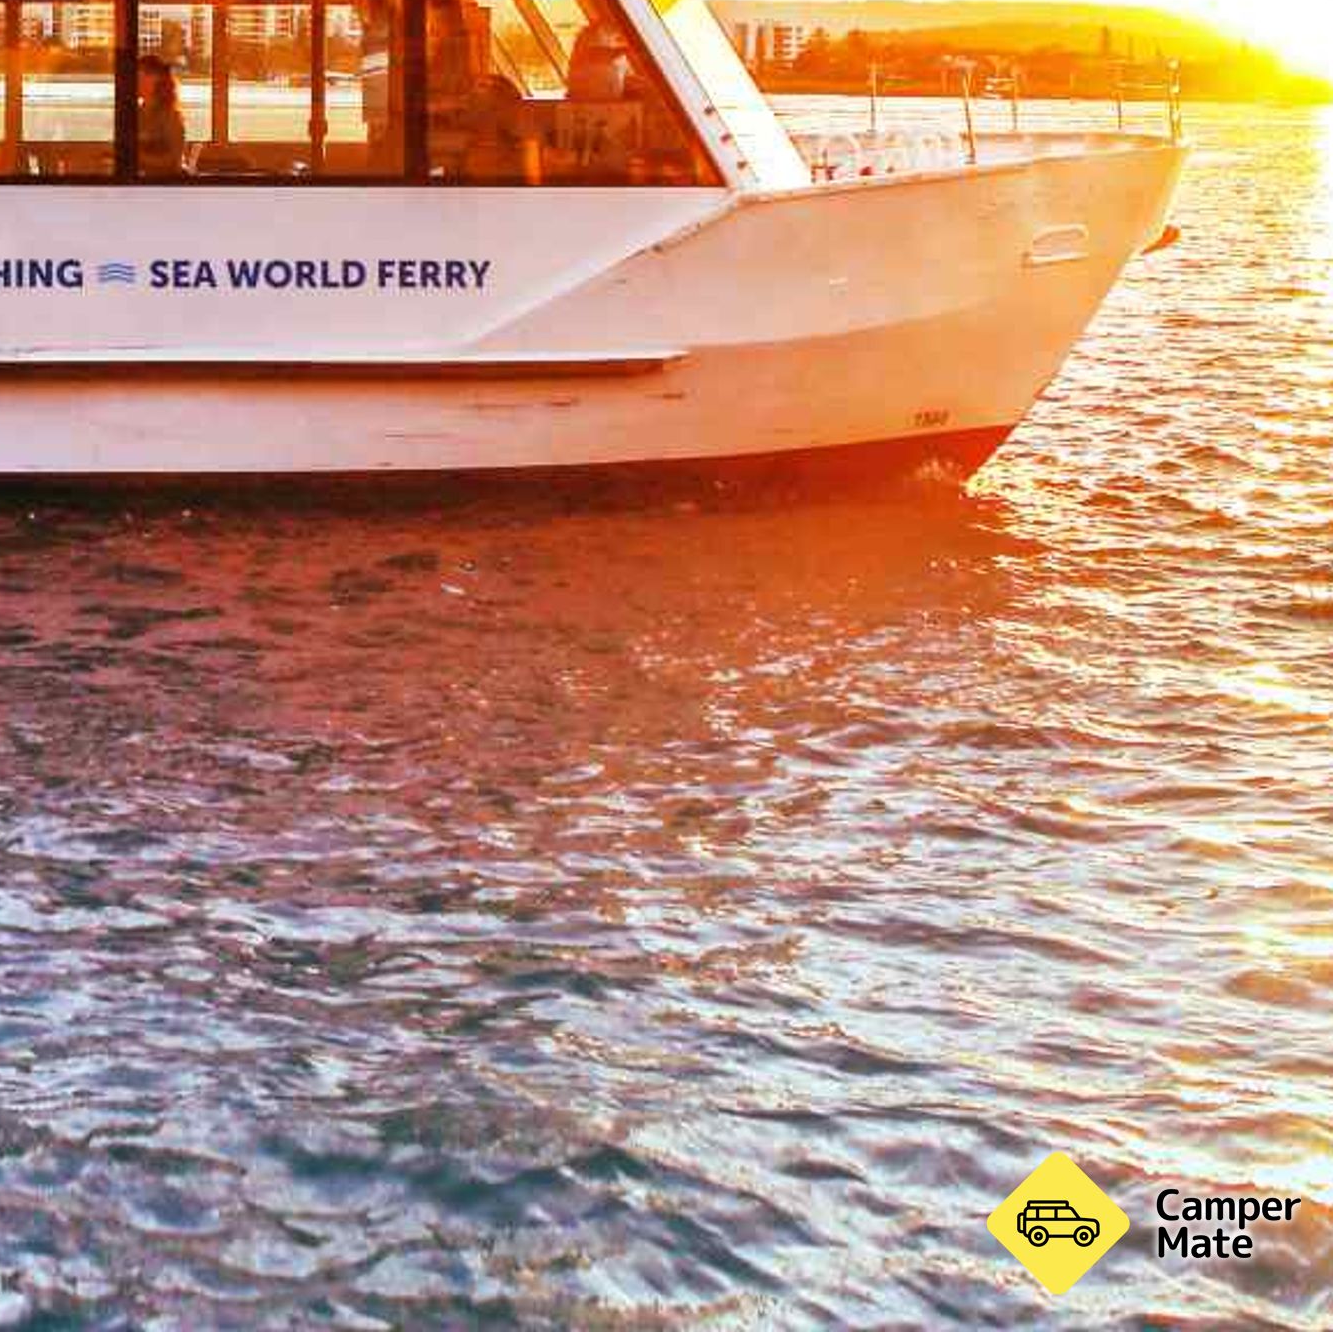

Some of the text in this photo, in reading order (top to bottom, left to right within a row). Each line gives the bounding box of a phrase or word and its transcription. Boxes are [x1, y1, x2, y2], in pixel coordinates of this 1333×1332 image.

[150, 260, 217, 288] SEA
[227, 260, 366, 288] WORLD
[378, 260, 490, 288] FERRY
